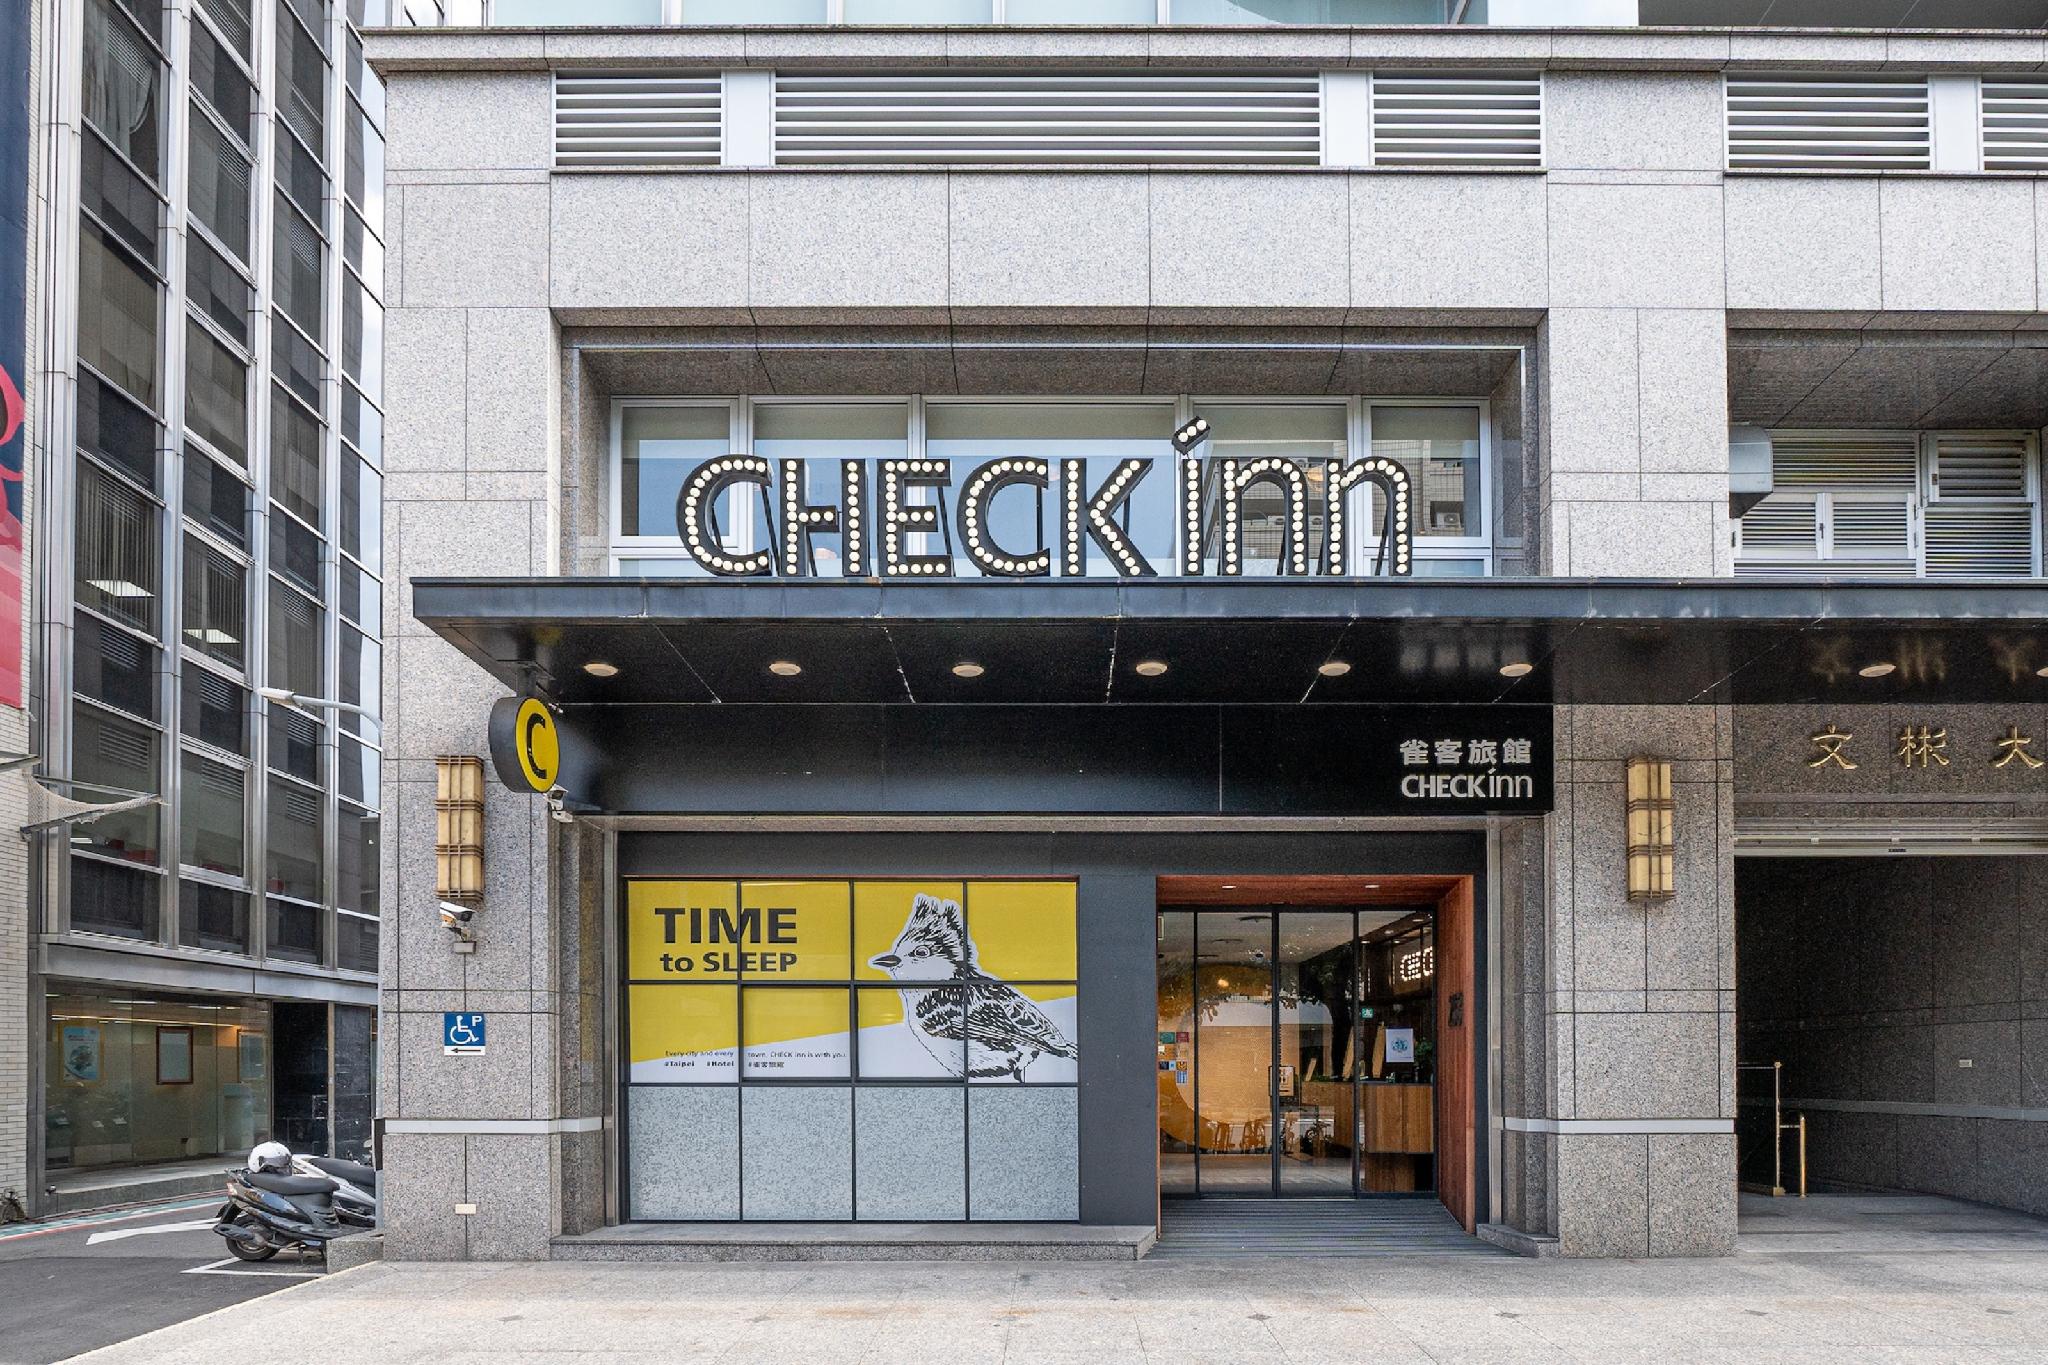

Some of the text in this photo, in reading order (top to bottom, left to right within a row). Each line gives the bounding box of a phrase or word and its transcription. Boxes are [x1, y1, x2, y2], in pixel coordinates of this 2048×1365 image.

[676, 454, 1158, 577] CHECK
[526, 712, 547, 779] C
[1400, 737, 1532, 765] 雀客旅館
[655, 907, 798, 944] TIME
[659, 952, 798, 972] to SLEEP
[472, 1015, 483, 1026] P
